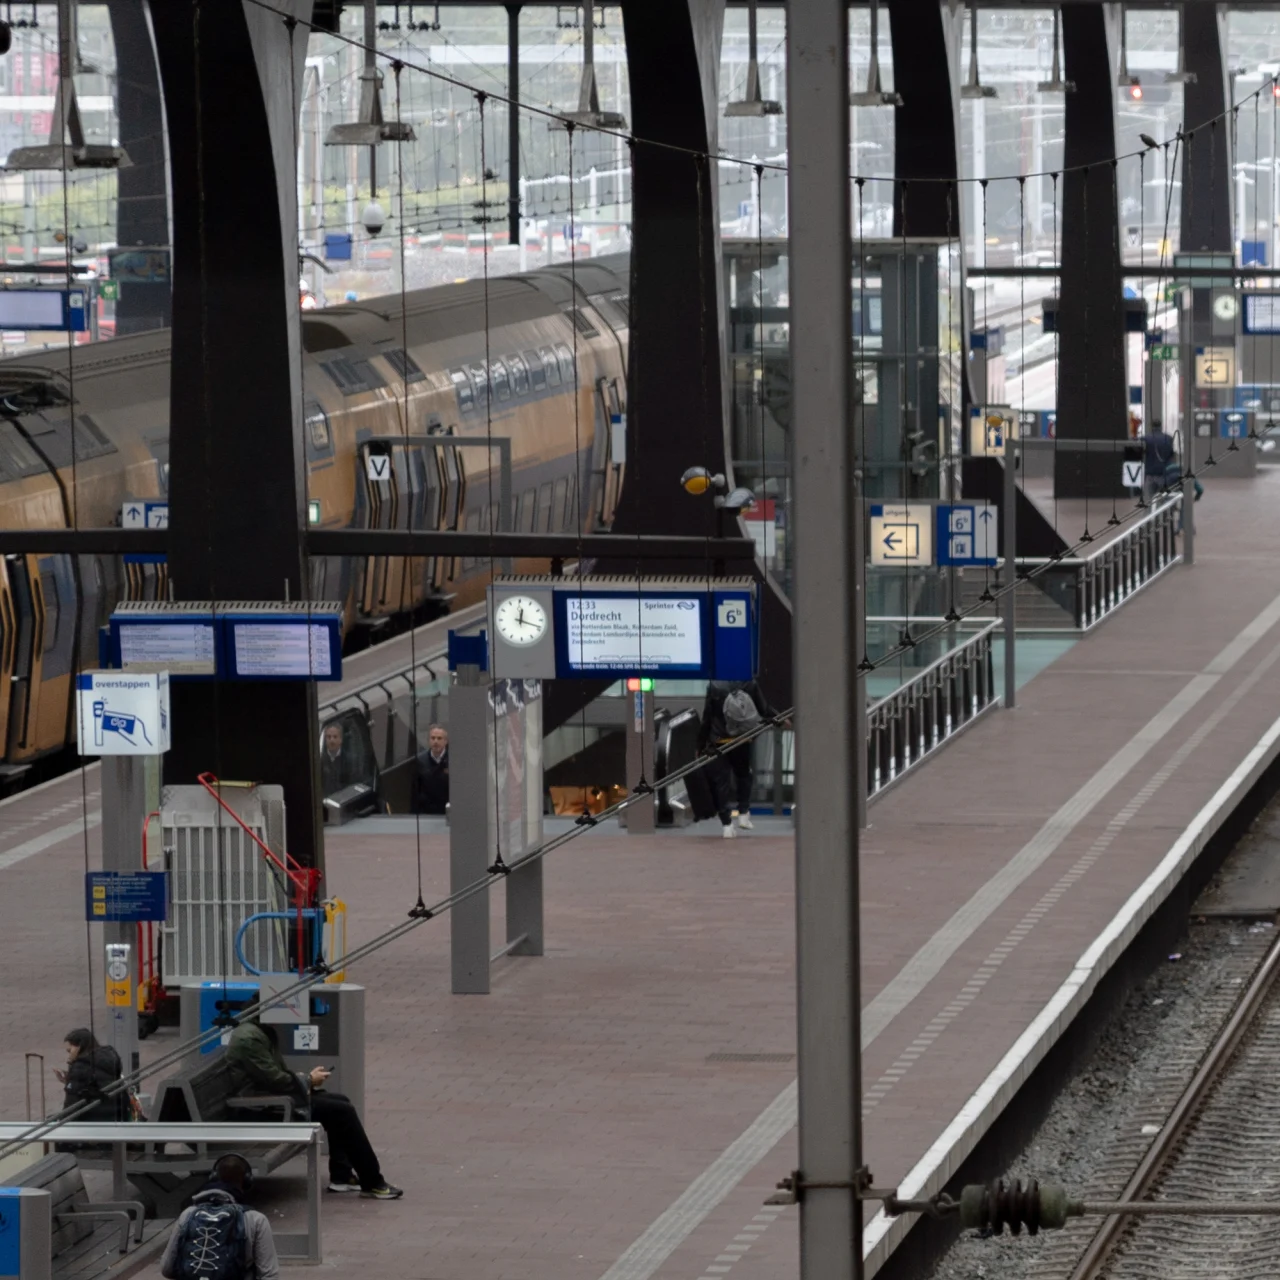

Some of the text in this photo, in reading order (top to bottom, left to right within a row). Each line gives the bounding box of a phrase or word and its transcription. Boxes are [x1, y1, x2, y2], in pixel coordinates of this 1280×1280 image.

[371, 458, 387, 477] V
[1126, 464, 1142, 483] V
[644, 602, 675, 611] Sprinter
[571, 611, 622, 621] Dordrecht
[95, 680, 150, 689] overstappen
